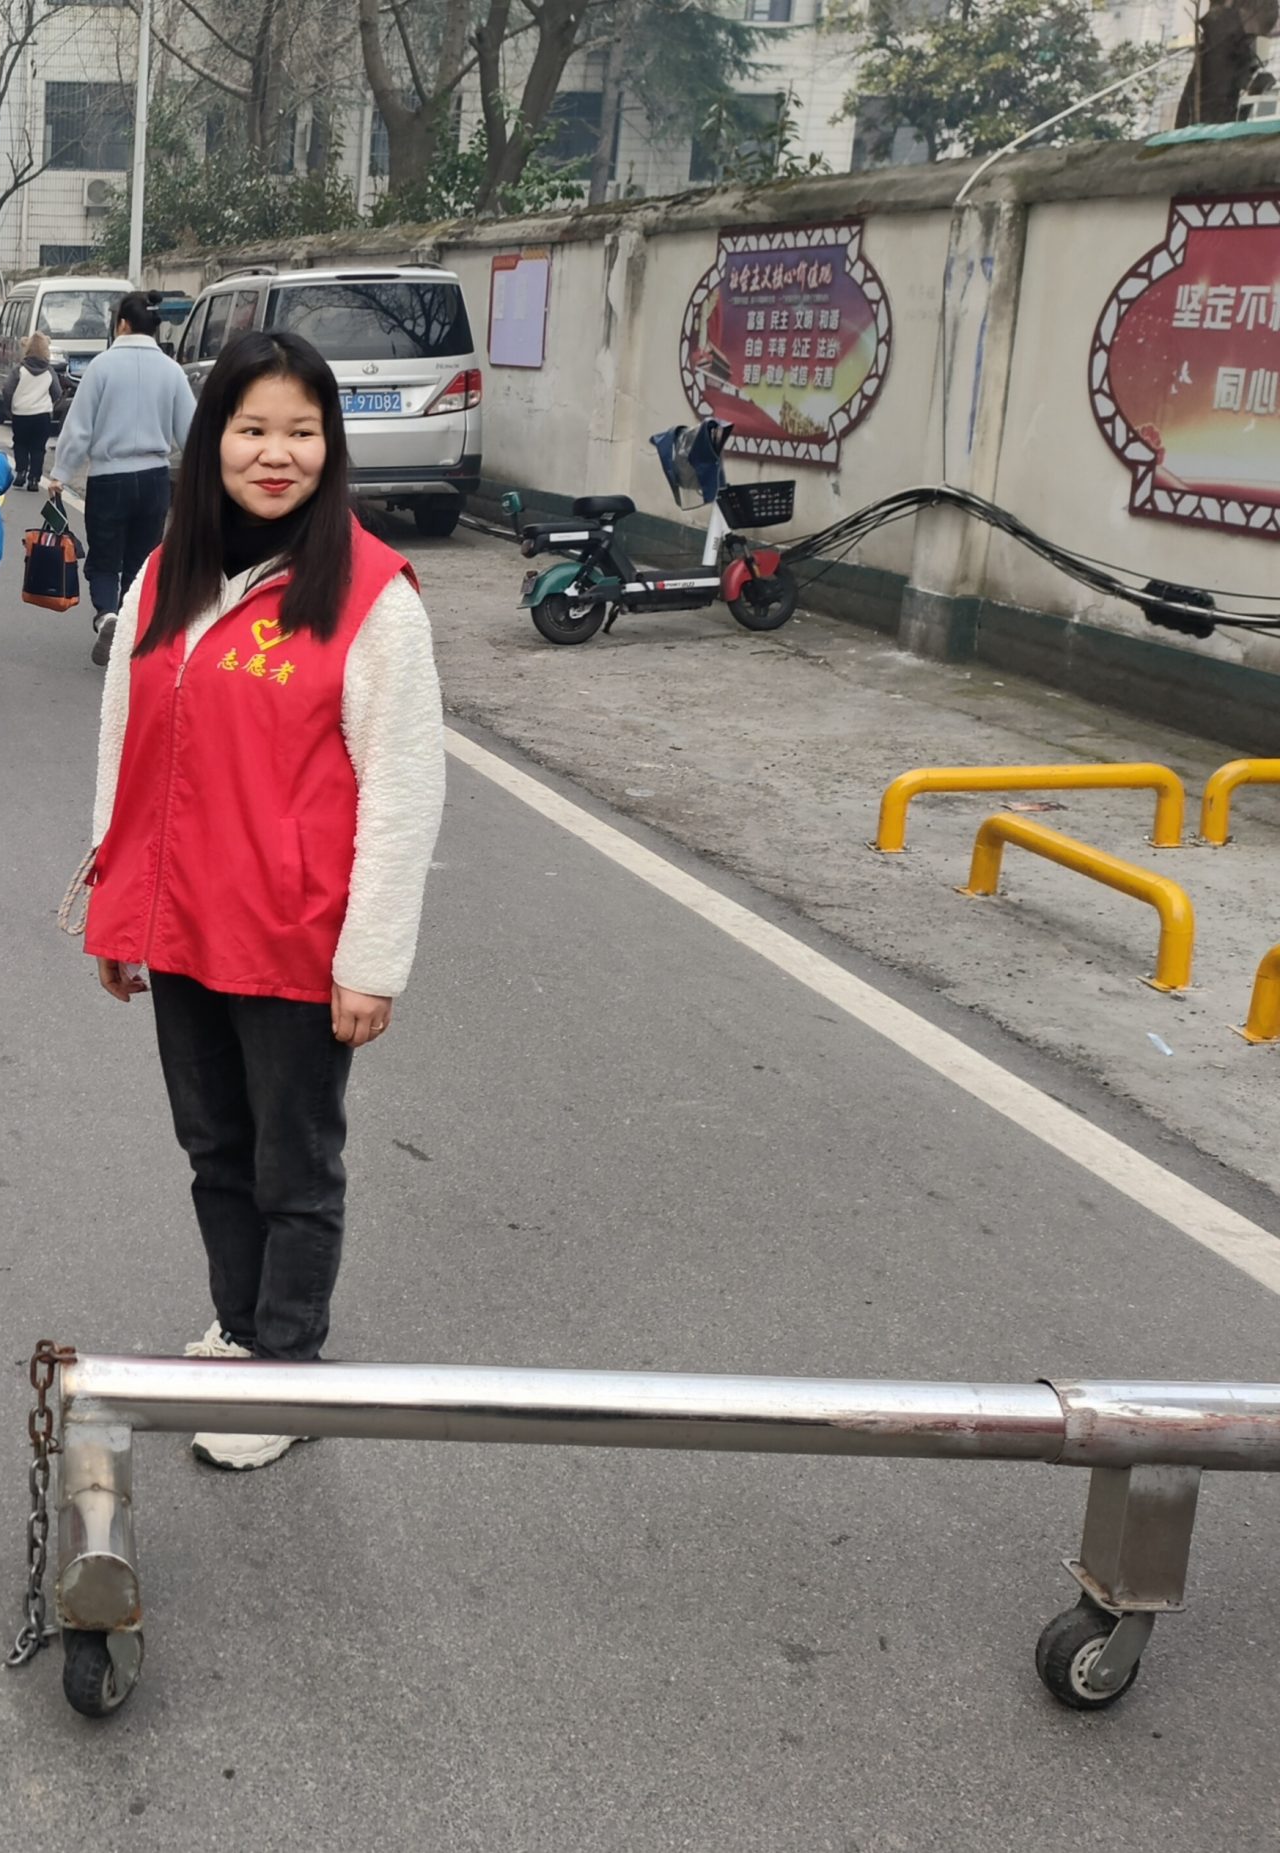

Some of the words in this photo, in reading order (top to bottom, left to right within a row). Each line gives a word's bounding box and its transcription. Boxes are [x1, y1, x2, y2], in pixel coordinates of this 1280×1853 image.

[746, 310, 765, 331] 富强
[770, 310, 789, 330] 民主
[794, 309, 814, 330] 文明
[819, 308, 840, 331] 和谐
[744, 337, 763, 357] 自由
[768, 337, 787, 358] 平等
[791, 338, 811, 358] 公正
[816, 338, 836, 359] 法治
[743, 364, 761, 384] 爱国
[767, 364, 784, 385] 敬业
[789, 365, 808, 386] 诚信
[814, 366, 834, 388] 友善
[1213, 366, 1279, 415] 同心
[216, 647, 296, 686] 志愿者
